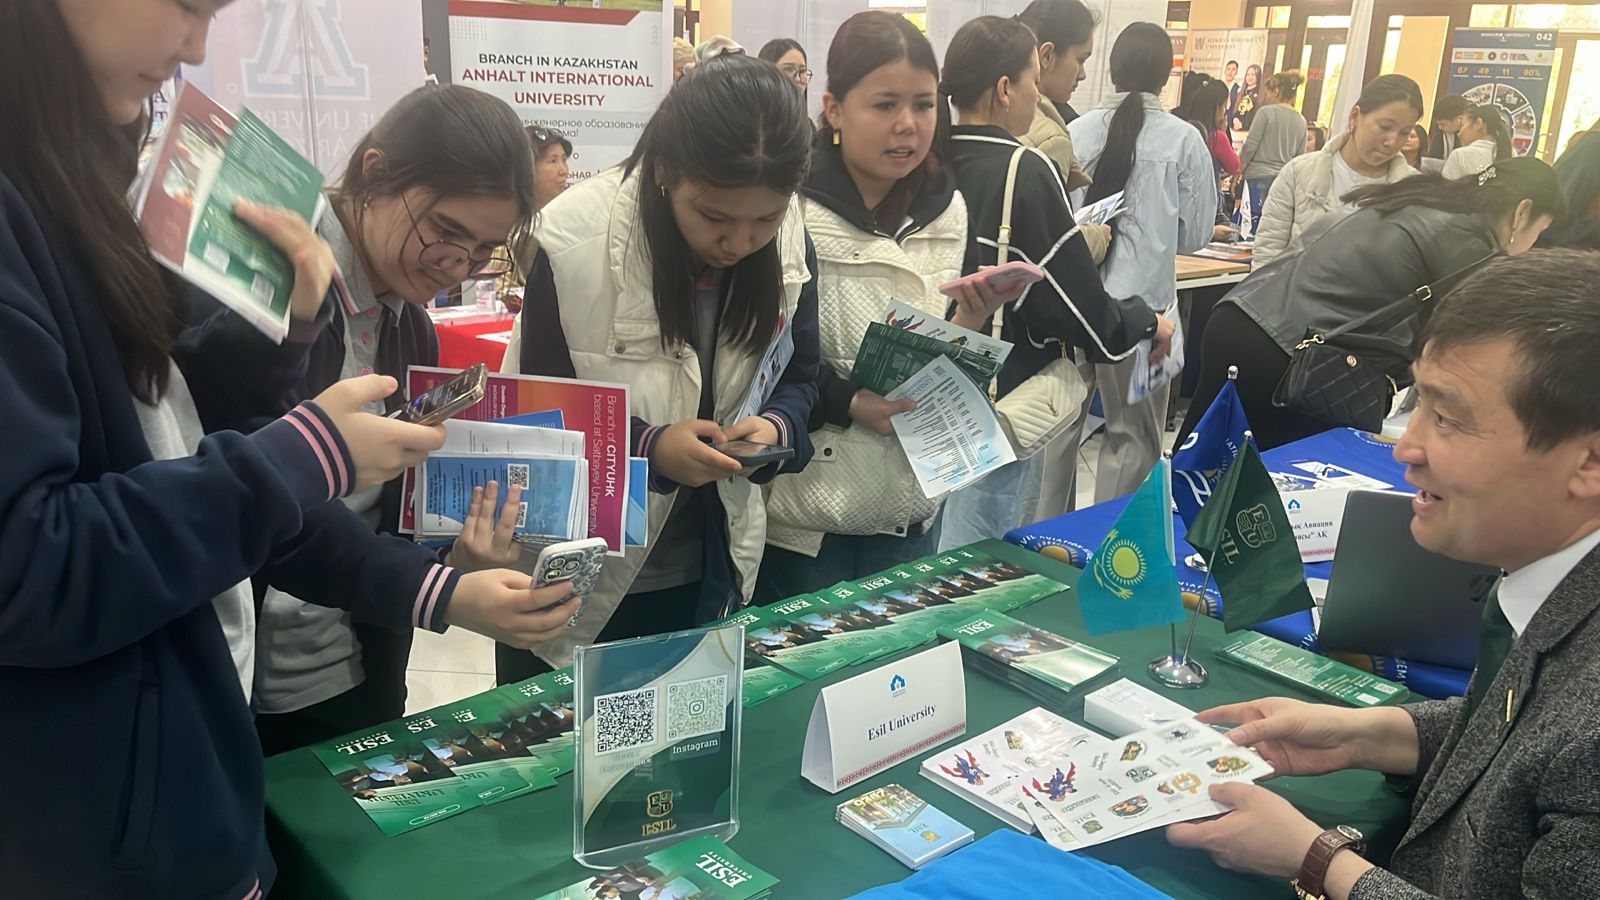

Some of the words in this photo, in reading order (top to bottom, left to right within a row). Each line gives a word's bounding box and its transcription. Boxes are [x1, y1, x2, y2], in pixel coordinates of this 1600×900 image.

[1536, 33, 1553, 41] 042
[479, 53, 533, 66] BRANCH
[536, 56, 550, 67] IN
[554, 57, 638, 70] KAZAKHSTAN
[462, 68, 526, 83] ANHALT
[530, 71, 654, 87] INTERNATIONAL
[514, 92, 605, 107] UNIVERSITY
[592, 394, 603, 426] based
[606, 395, 617, 431] Branch
[592, 427, 602, 438] at
[606, 433, 617, 444] of
[590, 438, 603, 485] Satbayev
[604, 445, 616, 498] CITYUHK
[588, 486, 600, 535] University
[860, 577, 894, 591] ESIL
[774, 600, 812, 615] ESIL
[958, 620, 996, 636] ESIL
[868, 723, 887, 742] Esil
[888, 704, 937, 731] University
[337, 733, 395, 756] ESIL
[672, 738, 719, 755] Instagram
[695, 853, 750, 889] ESIL
